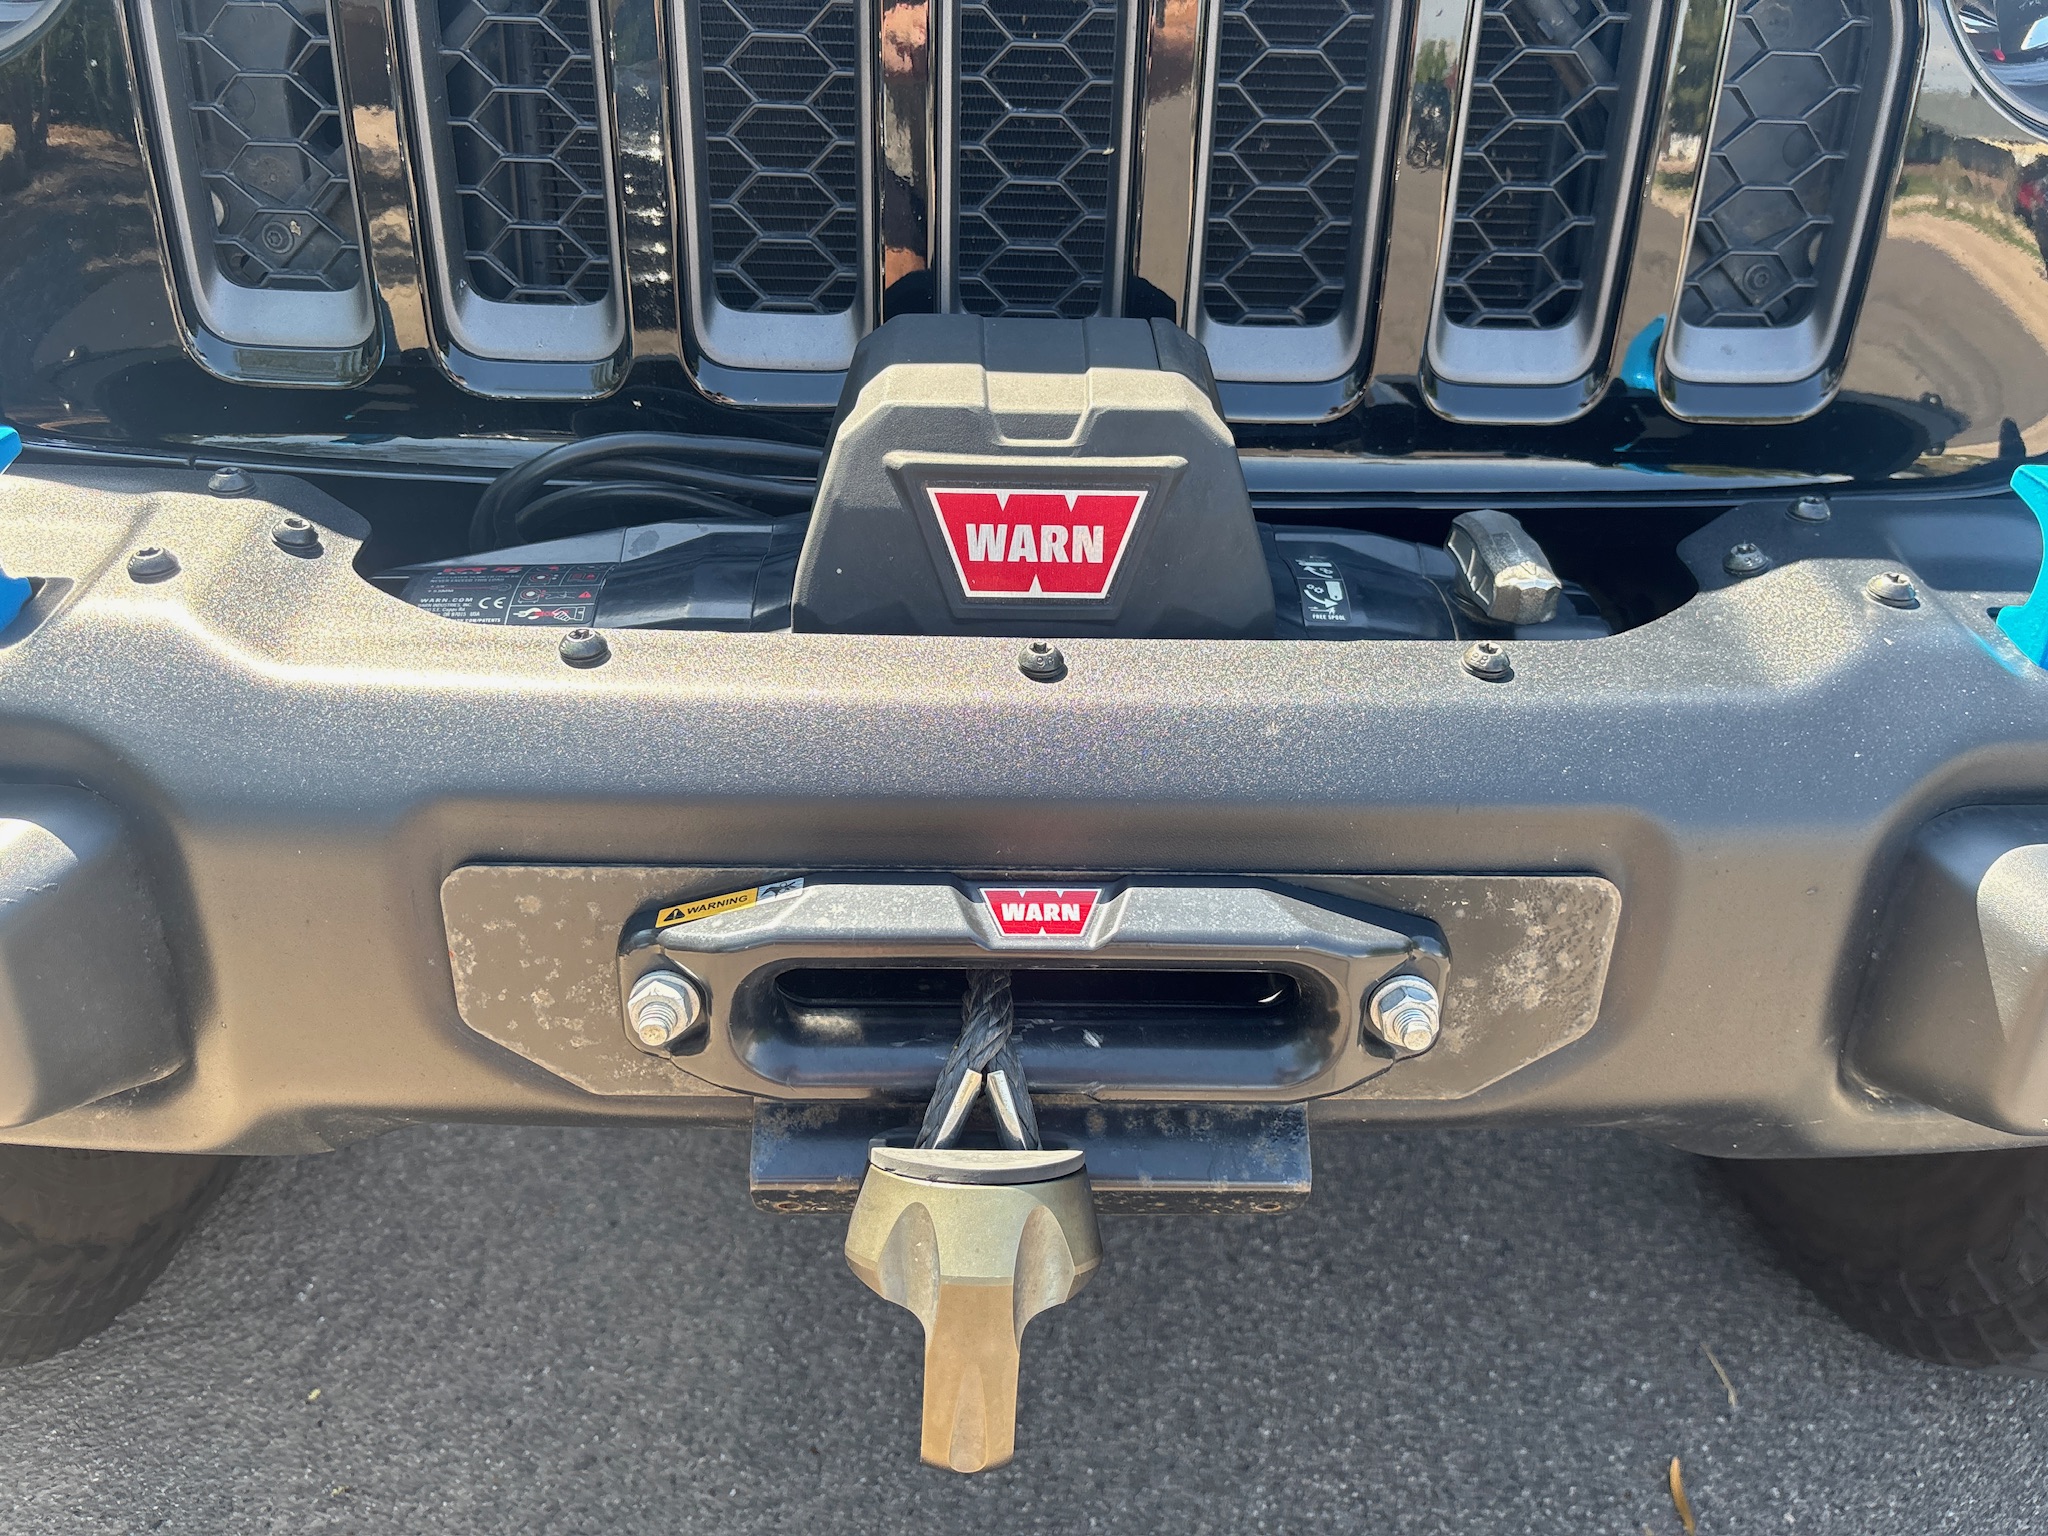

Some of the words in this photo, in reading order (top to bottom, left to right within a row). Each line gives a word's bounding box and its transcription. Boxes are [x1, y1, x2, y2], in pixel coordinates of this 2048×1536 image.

[965, 523, 1105, 564] WARN
[478, 597, 507, 609] CE
[687, 894, 749, 915] WARNING
[1001, 903, 1081, 922] WARN
